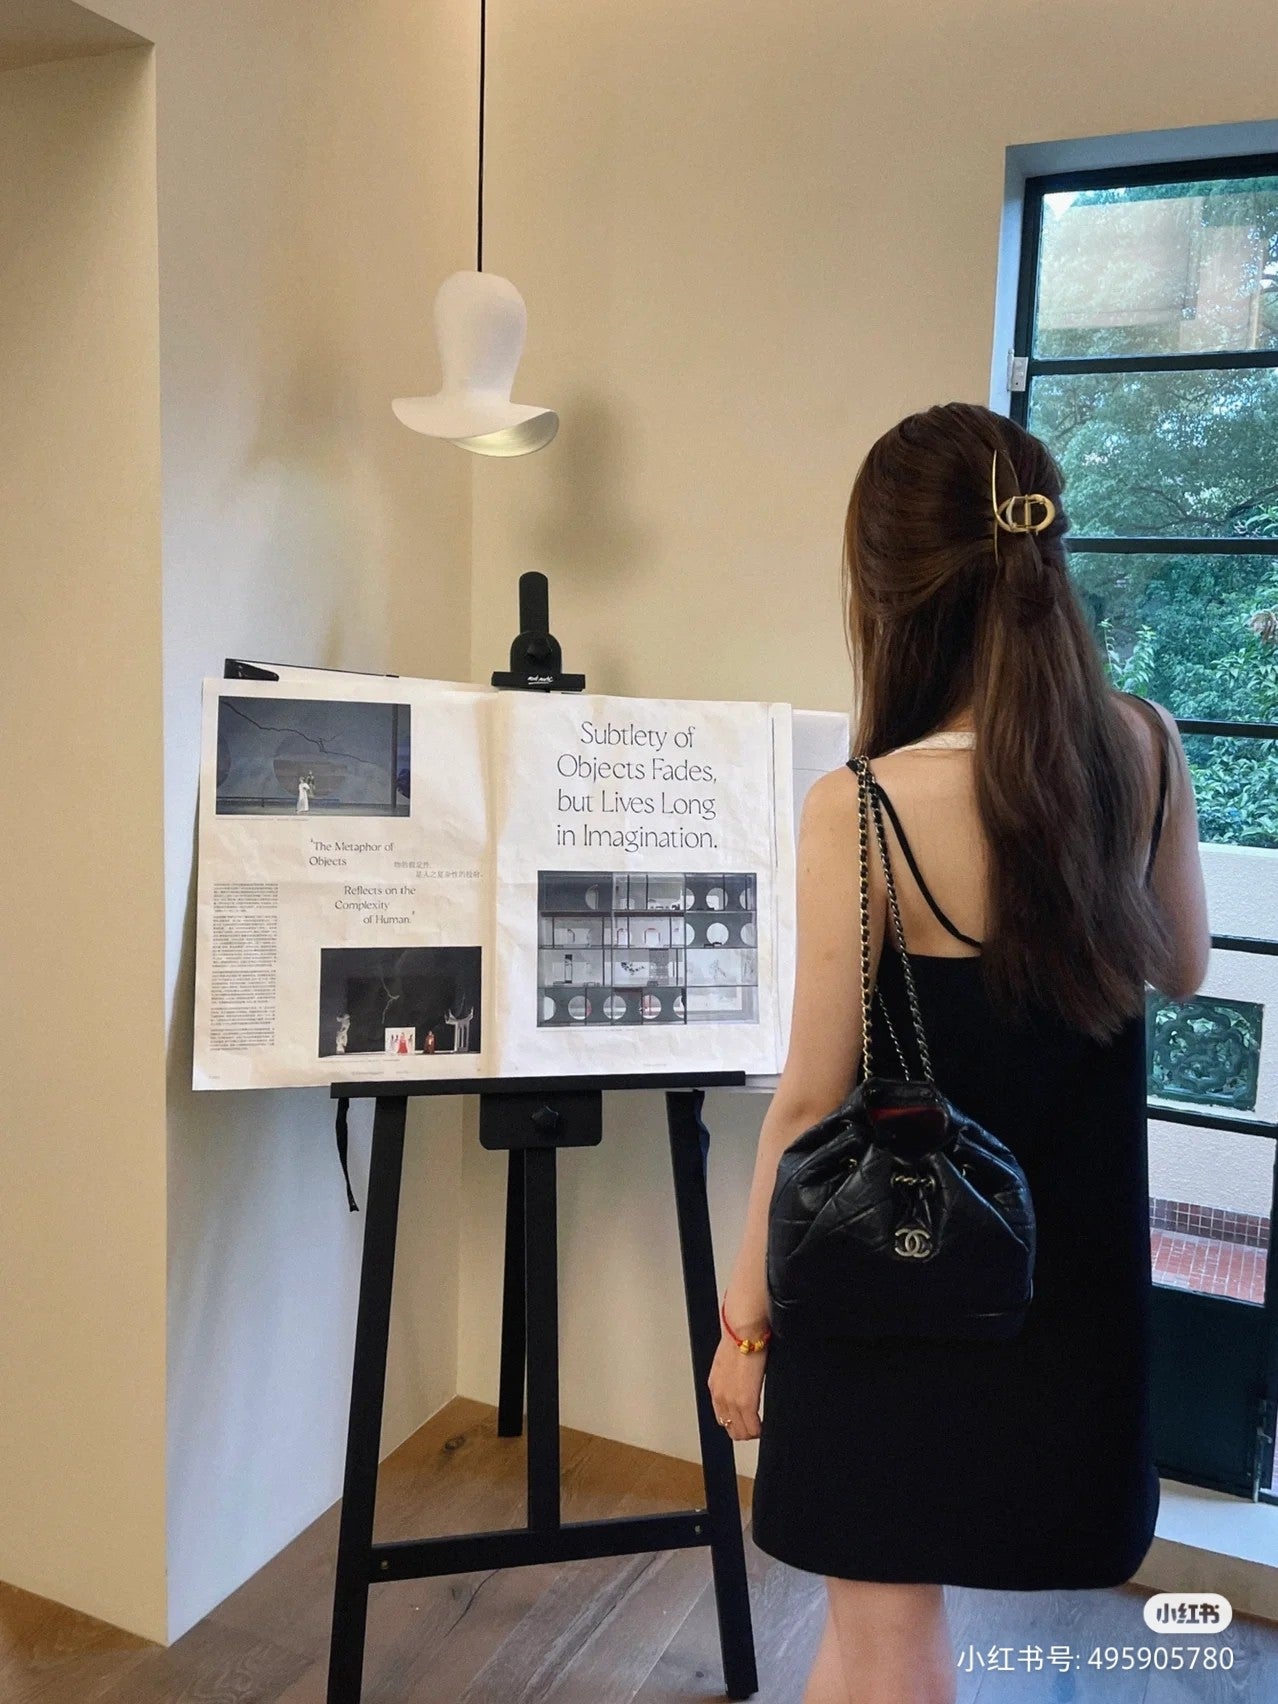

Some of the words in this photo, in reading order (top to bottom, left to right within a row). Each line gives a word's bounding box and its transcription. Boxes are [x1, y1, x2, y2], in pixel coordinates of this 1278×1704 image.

[580, 721, 667, 752] Subtlety
[674, 726, 696, 748] of
[557, 753, 646, 783] Objects
[652, 757, 717, 784] Fades,
[557, 788, 593, 813] but
[602, 789, 655, 814] Lives
[661, 791, 717, 821] Long
[557, 824, 576, 846] in
[583, 823, 718, 853] Imagination.
[334, 842, 381, 853] Metaphor
[384, 842, 395, 851] of
[308, 856, 347, 867] Objects
[344, 885, 383, 896] Reflects
[385, 887, 398, 896] on
[400, 885, 416, 896] the
[334, 900, 390, 912] Complexity
[363, 915, 373, 925] of
